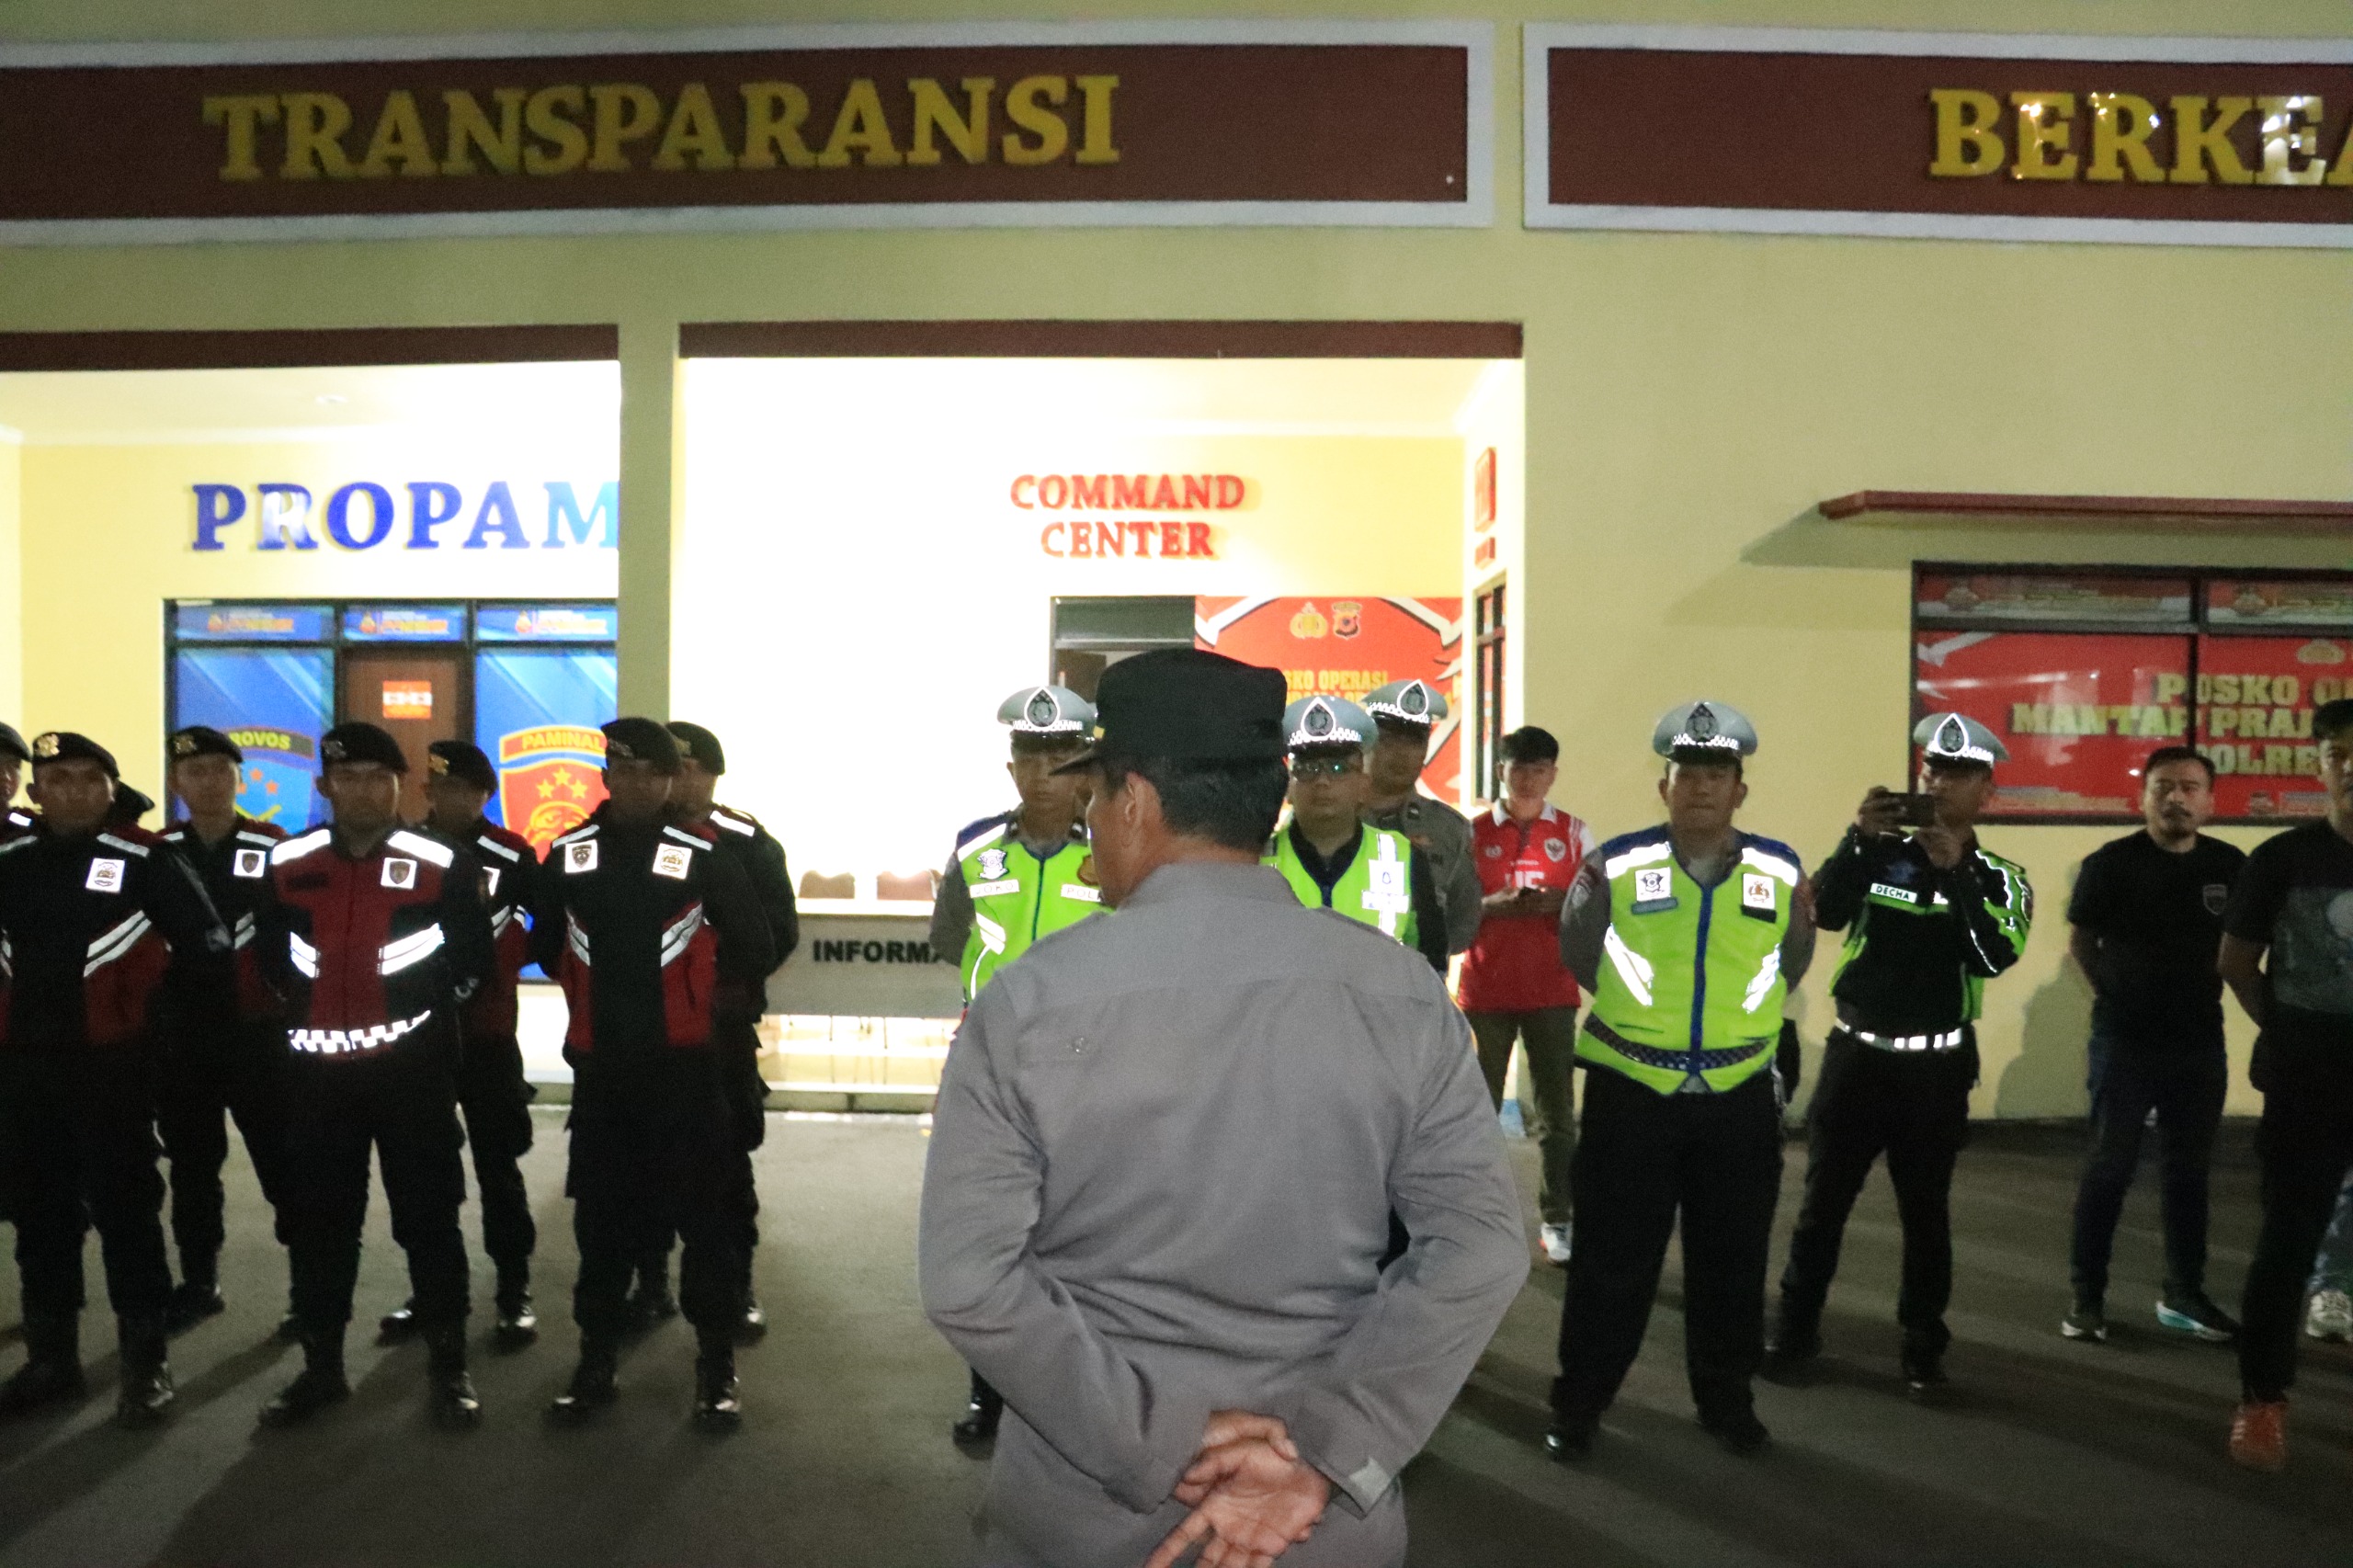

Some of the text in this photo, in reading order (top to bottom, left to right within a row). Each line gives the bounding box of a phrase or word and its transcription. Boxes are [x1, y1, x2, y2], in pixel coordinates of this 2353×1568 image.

[202, 74, 1120, 182] TRANSPARANSI
[1010, 473, 1245, 511] COMMAND
[191, 481, 620, 551] PROPAM
[1040, 521, 1214, 559] CENTER
[1318, 669, 1389, 690] OPERASI
[521, 732, 606, 753] PAMINAL
[1876, 883, 1911, 902] DECHA
[813, 939, 945, 964] INFORM
